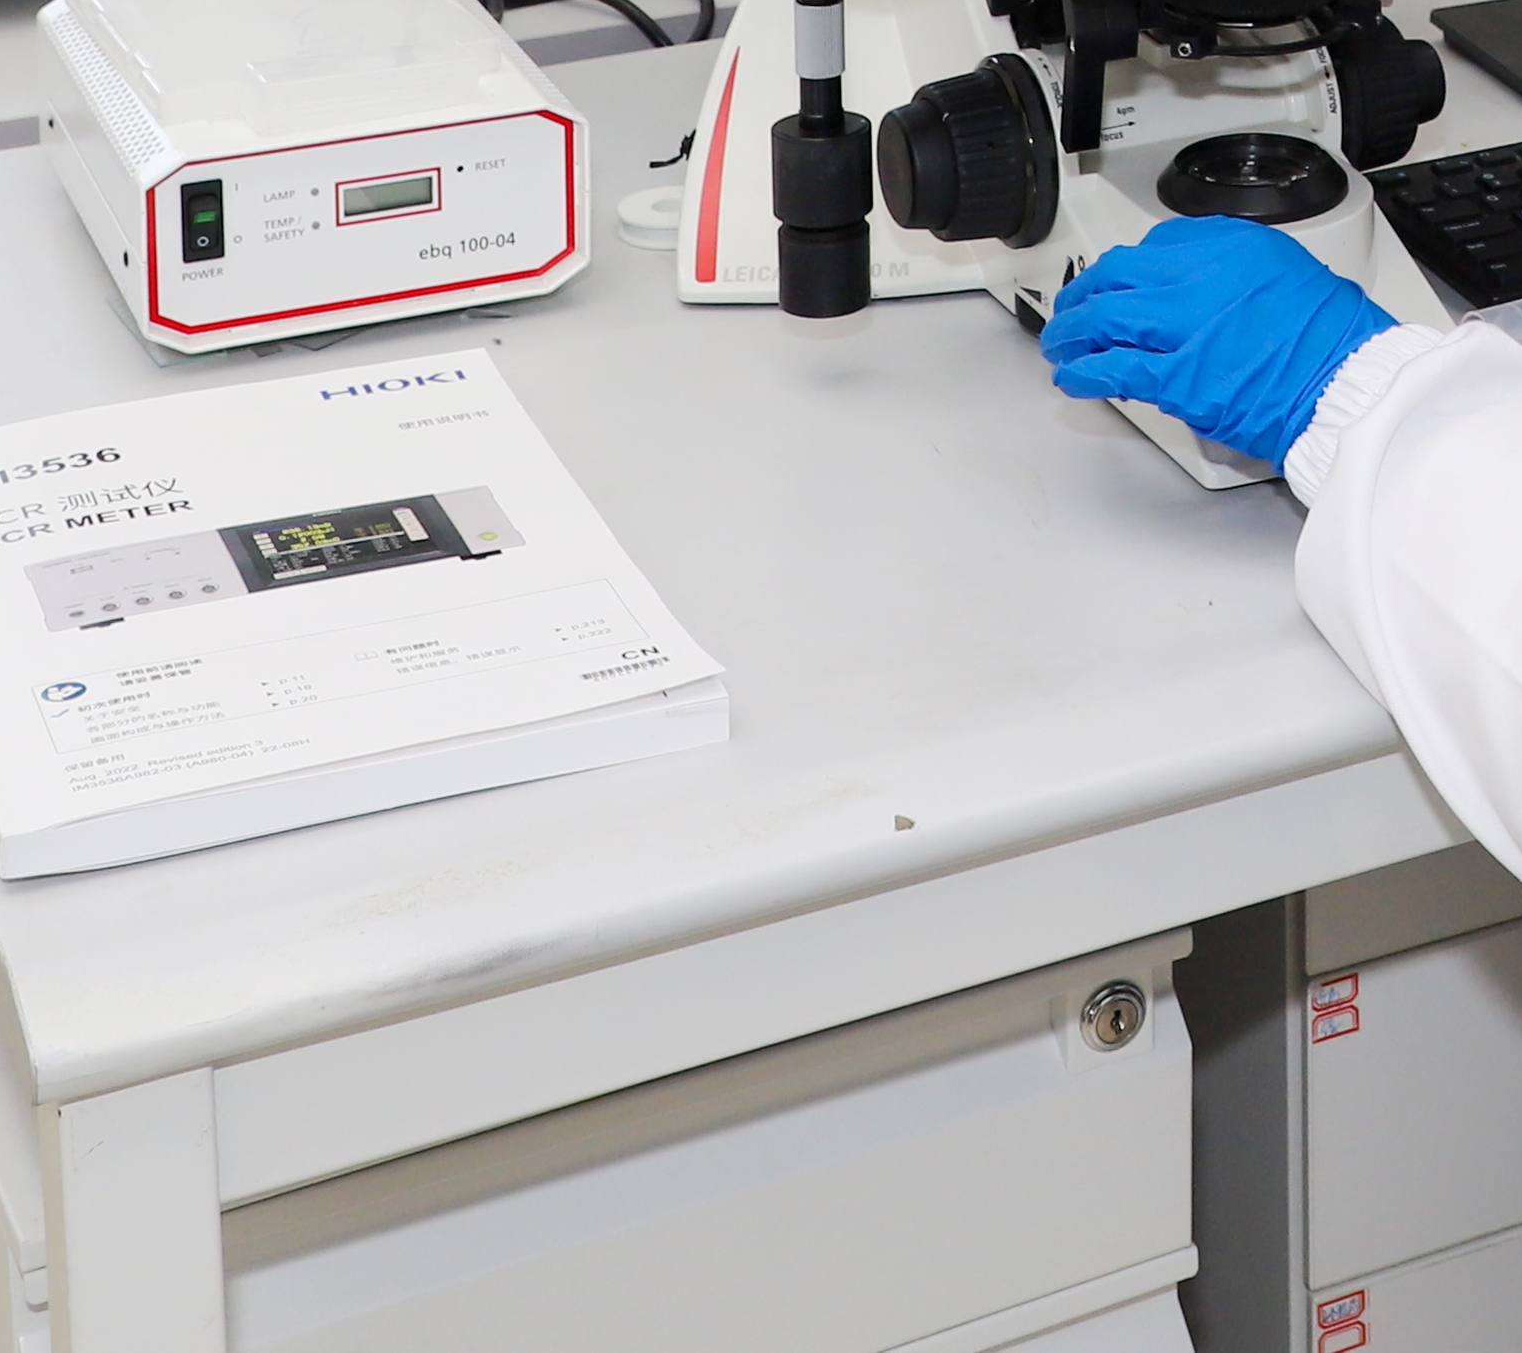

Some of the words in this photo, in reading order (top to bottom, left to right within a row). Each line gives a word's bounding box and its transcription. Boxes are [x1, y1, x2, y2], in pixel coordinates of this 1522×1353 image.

[474, 158, 506, 172] RESET
[263, 189, 295, 203] LAMP
[264, 228, 305, 244] SAFETY
[419, 243, 452, 260] ebq
[459, 231, 516, 254] 100-04
[182, 266, 224, 283] POWER
[319, 368, 468, 401] HIOKI
[56, 476, 184, 512] 测试仪
[64, 498, 194, 531] METER
[620, 646, 660, 661] CN
